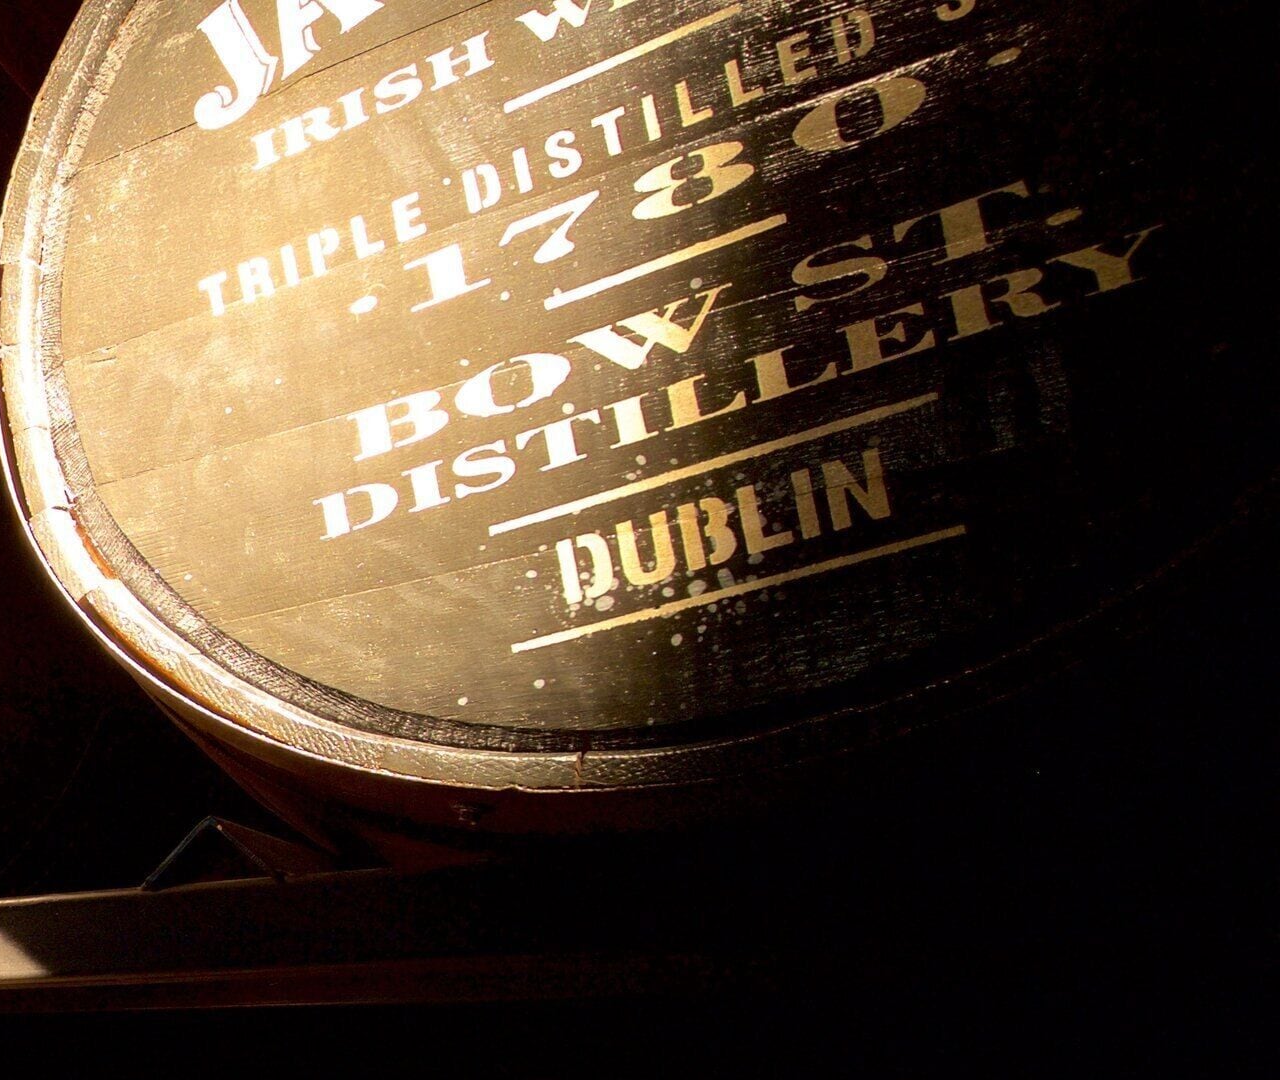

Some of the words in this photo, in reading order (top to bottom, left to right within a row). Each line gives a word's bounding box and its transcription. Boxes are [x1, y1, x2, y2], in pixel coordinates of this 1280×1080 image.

[197, 194, 429, 317] TRIPLE
[466, 8, 877, 214] DISTILLED
[249, 31, 496, 171] IRISH
[311, 225, 1165, 542] DISTILLERY
[349, 281, 731, 462] BOW
[790, 180, 1083, 314] ST.
[556, 446, 892, 607] DUBLIN
